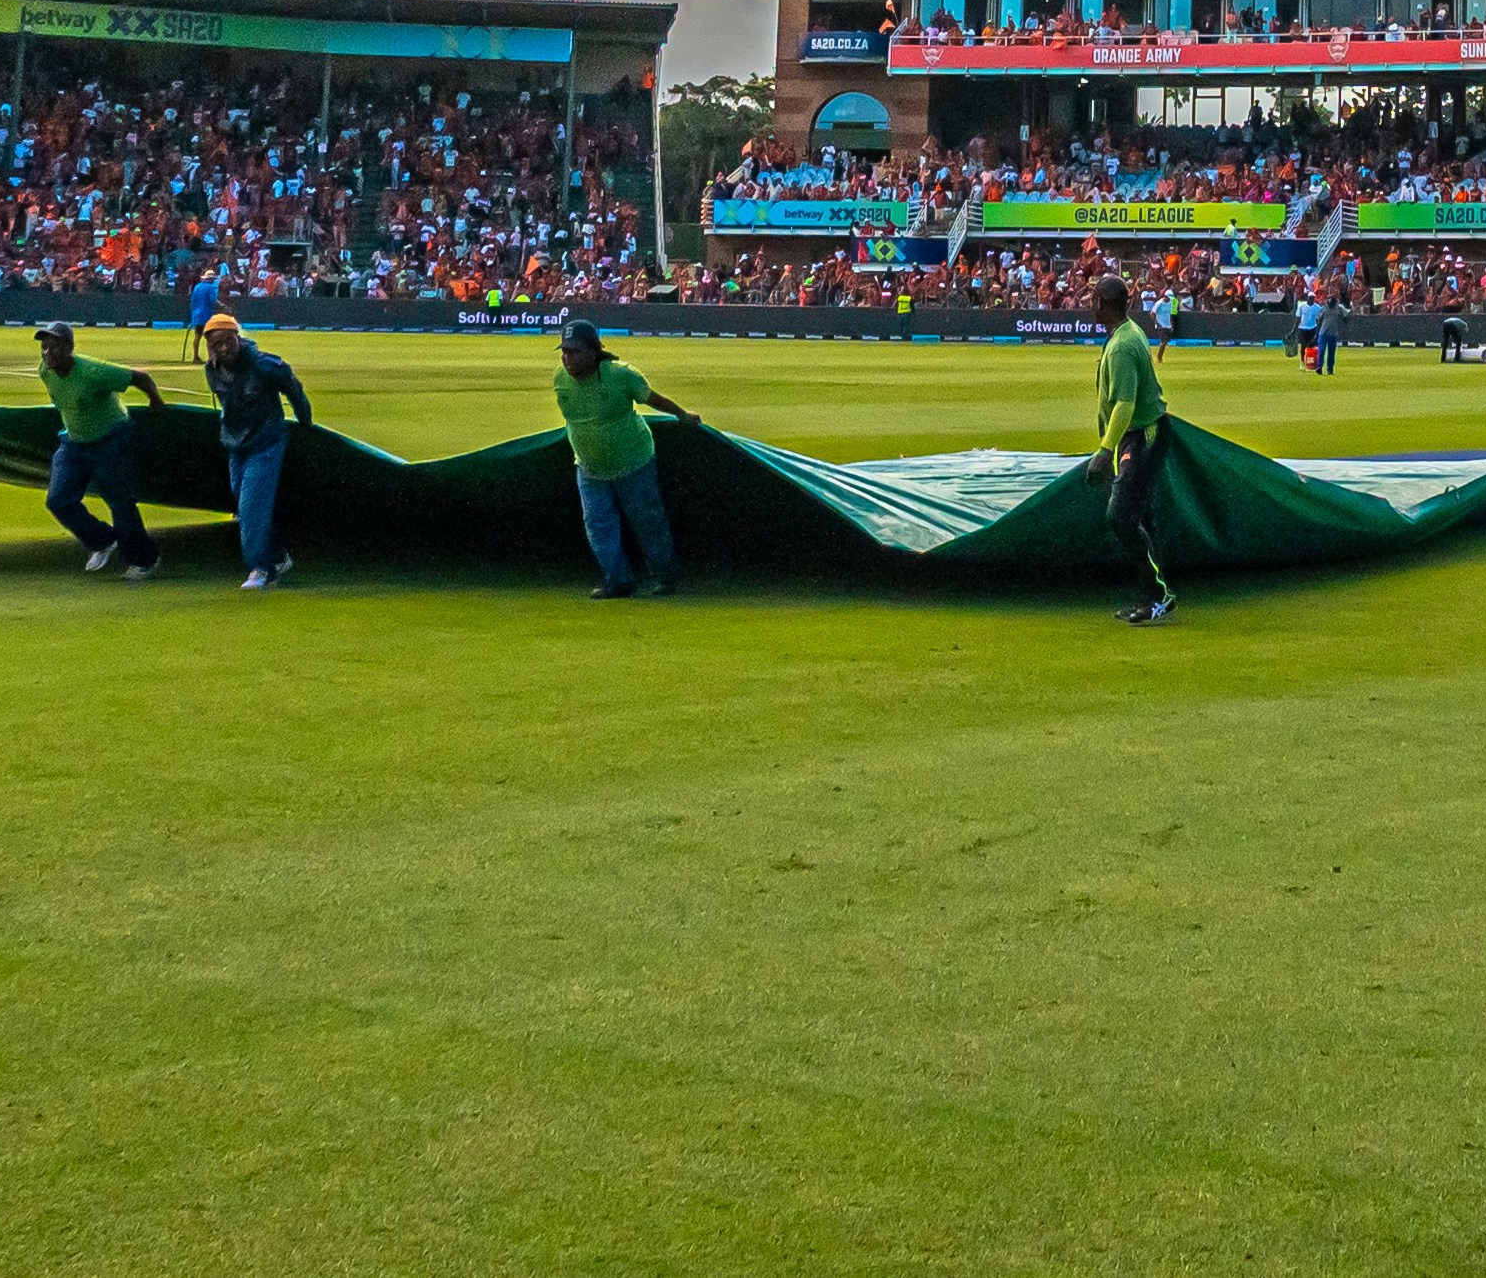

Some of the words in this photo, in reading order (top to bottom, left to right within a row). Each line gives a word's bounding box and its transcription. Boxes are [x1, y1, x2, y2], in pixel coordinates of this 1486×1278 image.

[20, 5, 96, 34] betway
[164, 11, 224, 42] SA20
[1092, 47, 1141, 64] ORANGE
[1145, 47, 1182, 64] ARMY
[784, 207, 823, 222] betway
[1075, 207, 1194, 224] @SA20_LEAGUE
[521, 311, 540, 324] for
[543, 307, 569, 325] sale
[1016, 319, 1072, 333] Software
[1075, 319, 1093, 333] for
